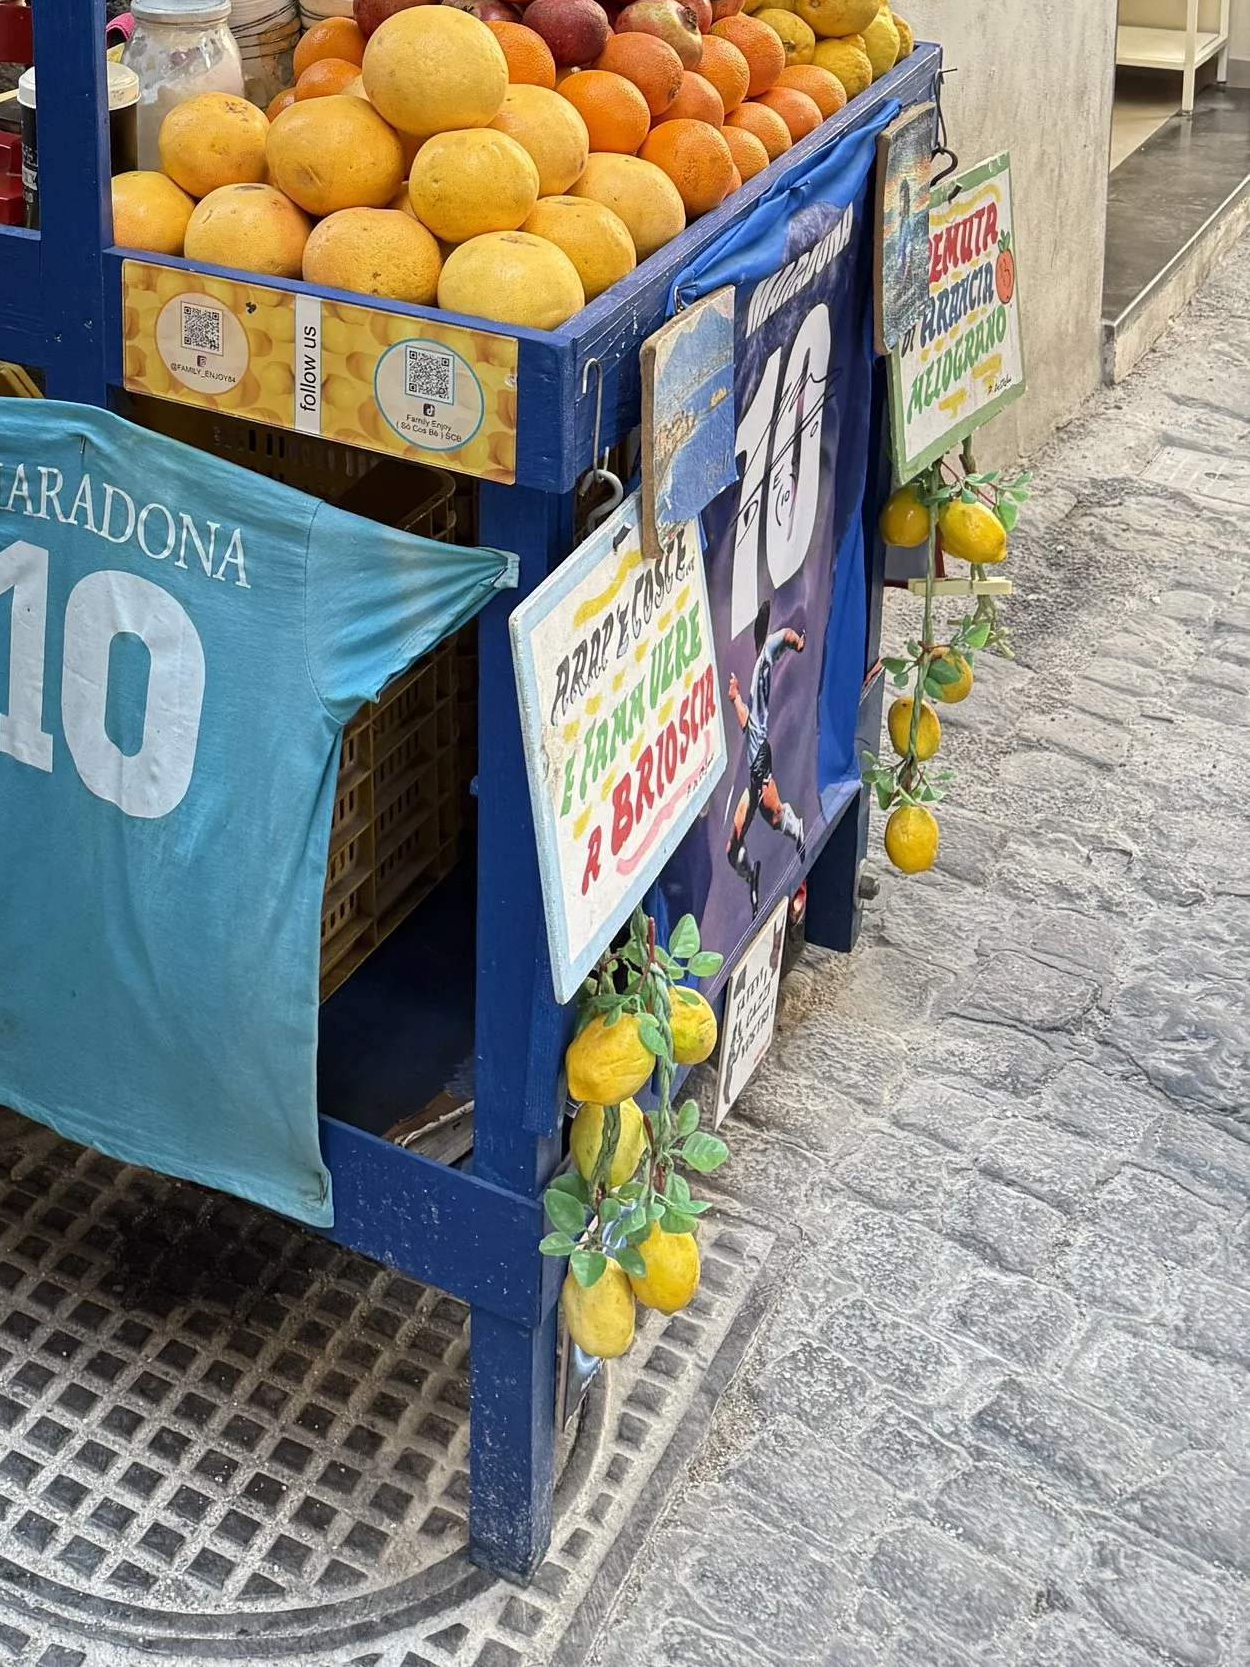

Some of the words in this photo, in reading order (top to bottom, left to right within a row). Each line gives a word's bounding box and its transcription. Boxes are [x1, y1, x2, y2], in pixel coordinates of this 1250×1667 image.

[304, 325, 317, 350] us
[920, 260, 994, 349] ARANCIA
[299, 354, 317, 413] follow
[907, 305, 1007, 425] MELOGRANO
[406, 414, 430, 427] Family
[431, 420, 452, 432] Enjoy
[731, 302, 831, 641] 10
[550, 611, 615, 727] ARAP
[560, 752, 575, 818] E
[610, 662, 716, 857] BRIOSCIA
